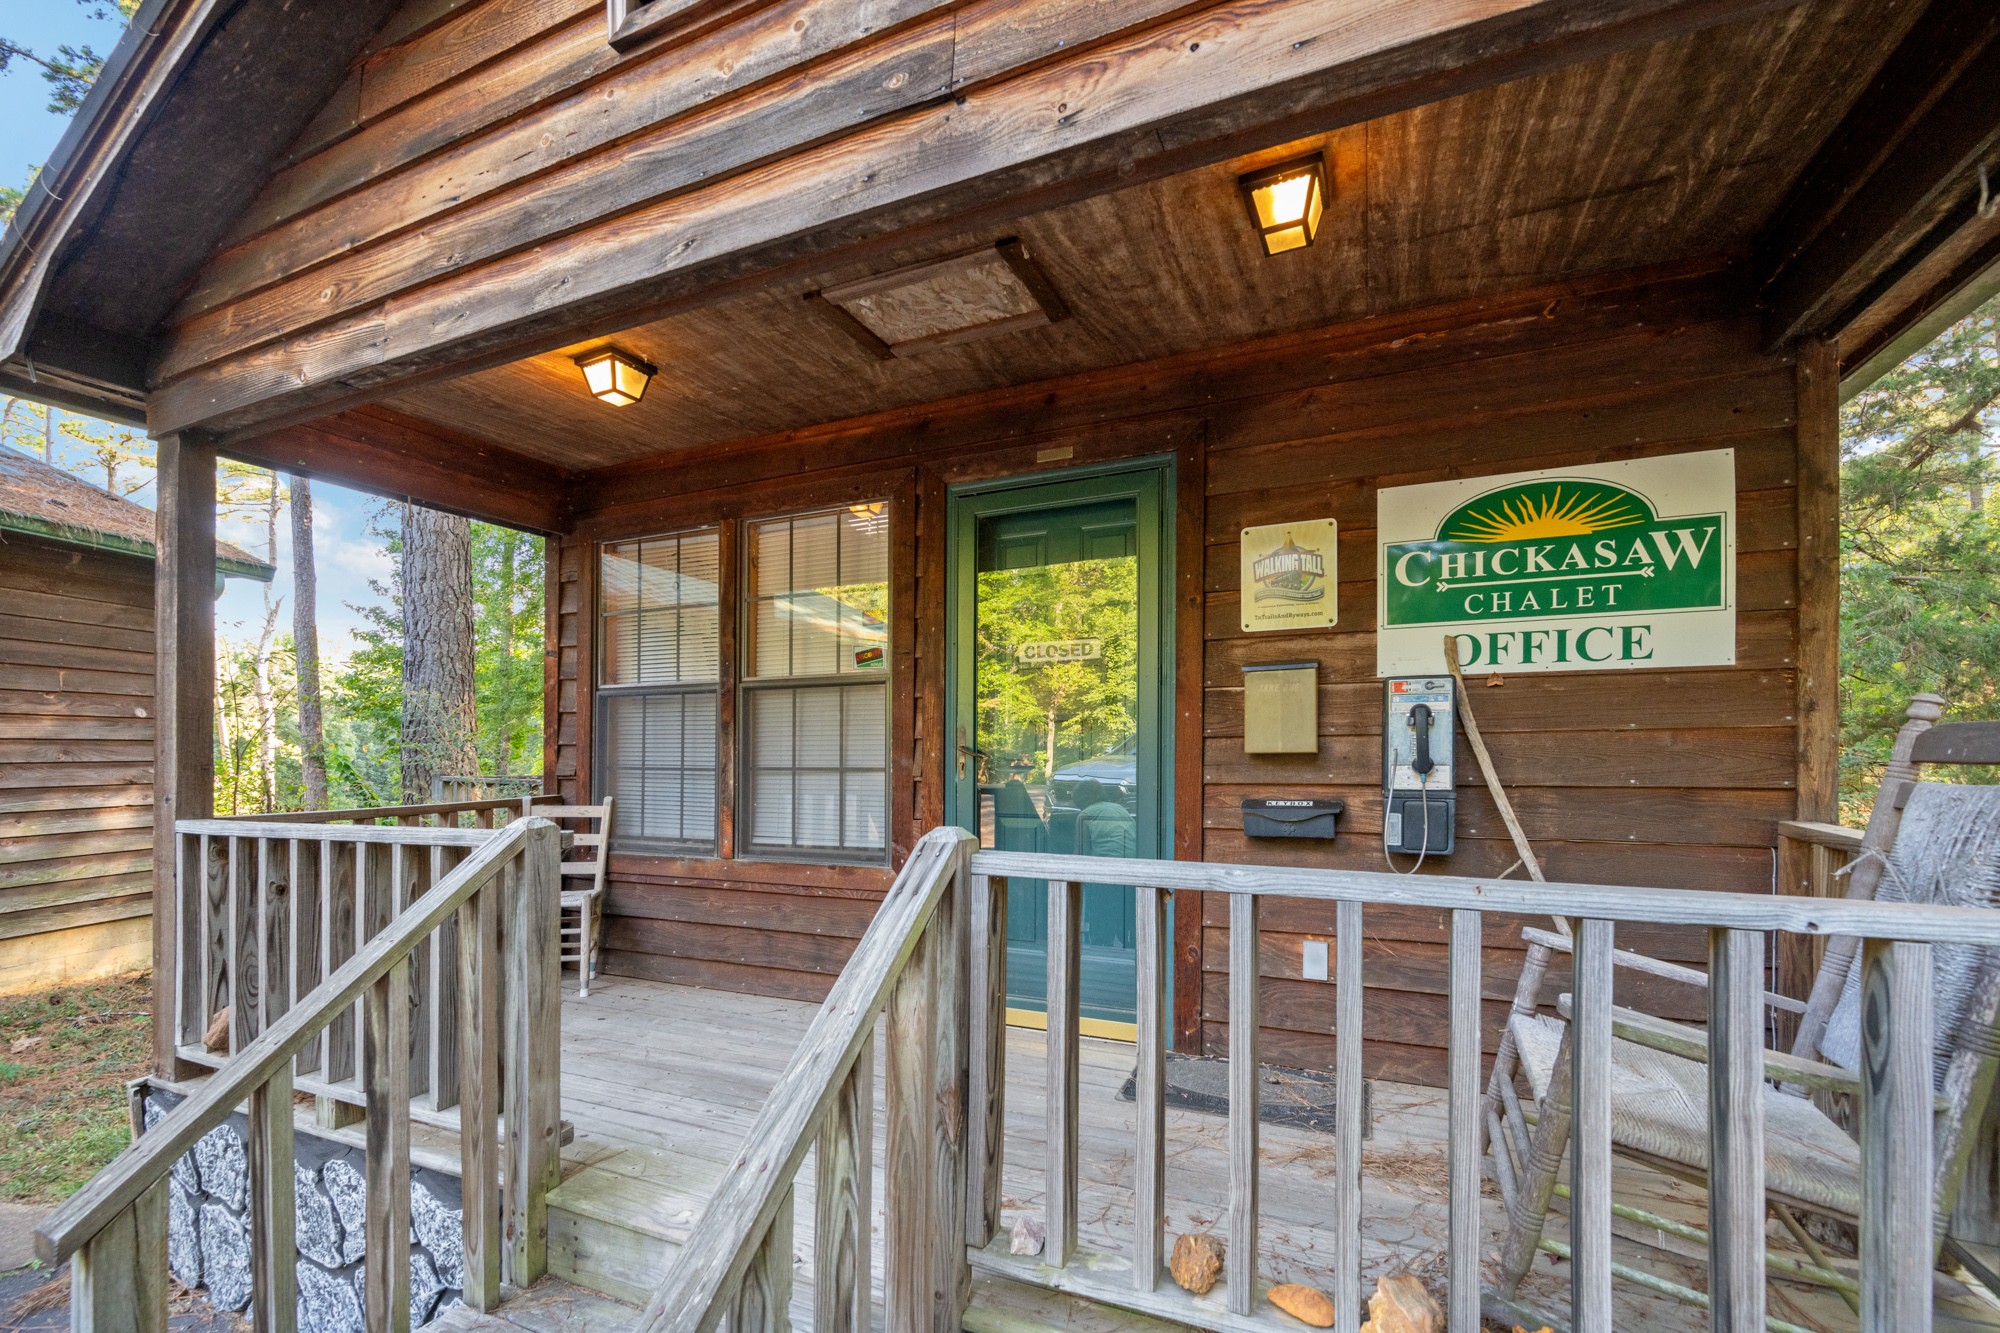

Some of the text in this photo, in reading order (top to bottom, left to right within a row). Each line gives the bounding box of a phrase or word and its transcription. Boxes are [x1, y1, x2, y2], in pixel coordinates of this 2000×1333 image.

[1254, 553, 1323, 581] WALKING TALL
[1395, 526, 1717, 587] CHICKASAW
[1464, 584, 1622, 614] CHALET
[1023, 641, 1094, 660] CLOSED
[1453, 624, 1654, 668] OFFICE
